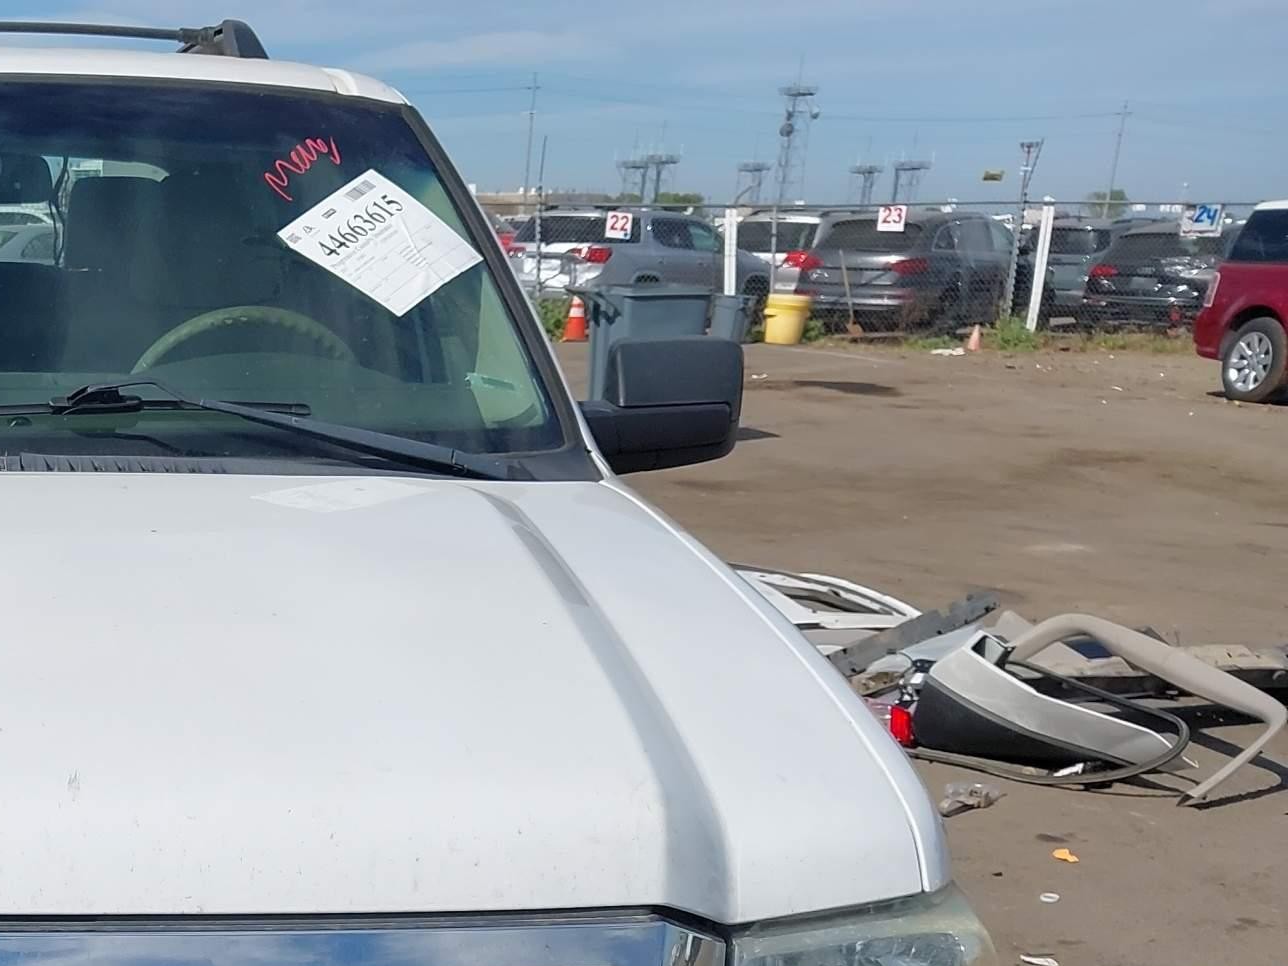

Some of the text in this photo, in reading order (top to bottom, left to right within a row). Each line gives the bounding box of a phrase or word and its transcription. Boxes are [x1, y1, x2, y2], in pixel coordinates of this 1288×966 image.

[610, 214, 629, 232] 22
[882, 206, 903, 223] 23
[1194, 205, 1218, 226] 24
[318, 194, 404, 257] 44663615
